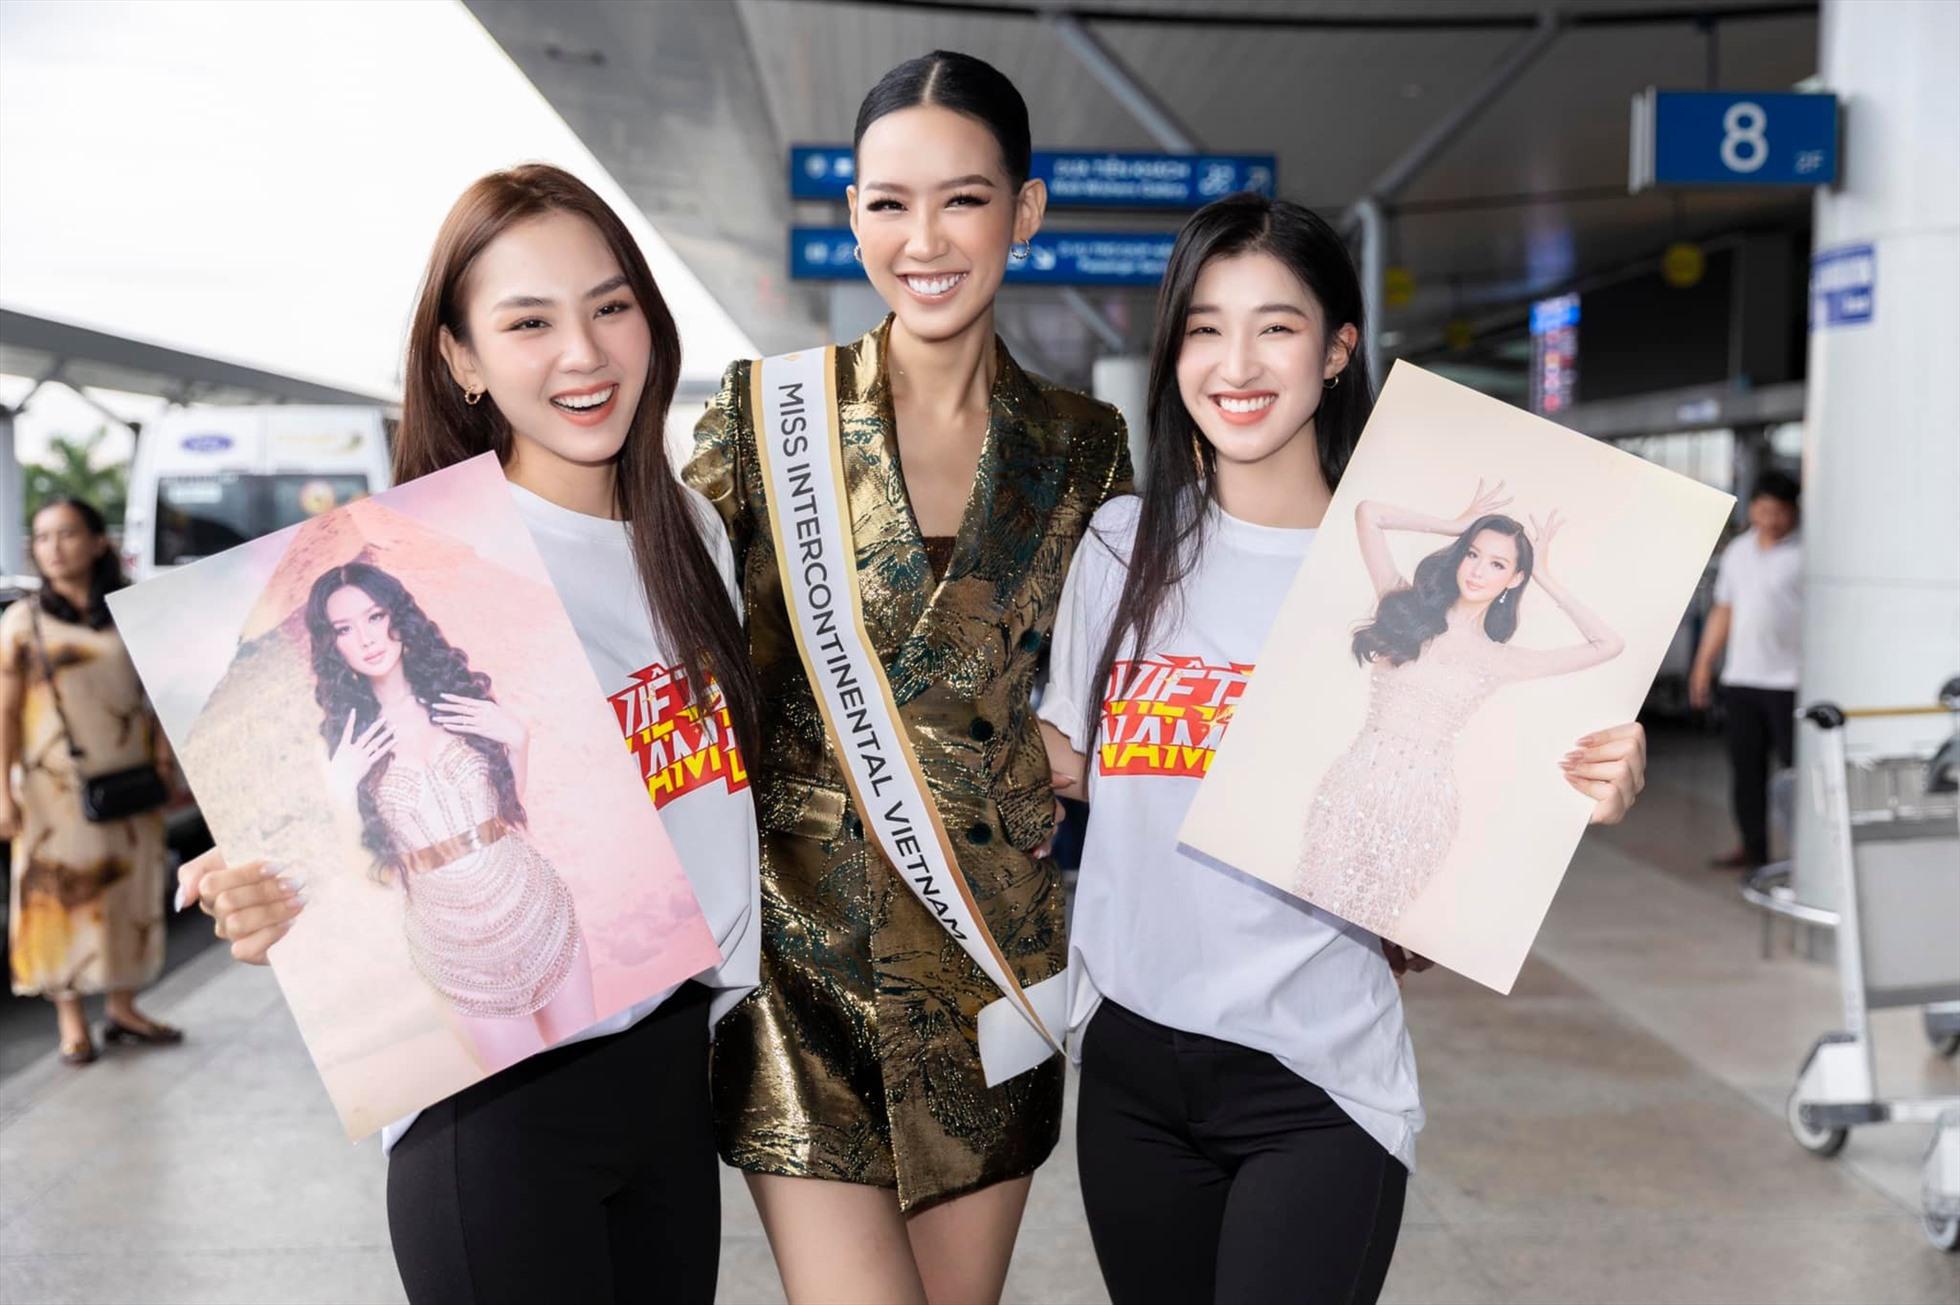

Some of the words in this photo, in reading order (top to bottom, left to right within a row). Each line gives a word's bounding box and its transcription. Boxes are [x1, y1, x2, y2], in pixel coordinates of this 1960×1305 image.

[1720, 102, 1769, 173] 8
[778, 383, 808, 457] MISS
[787, 463, 893, 797] INTERCONTINENTAL
[884, 801, 968, 941] VIETNAM
